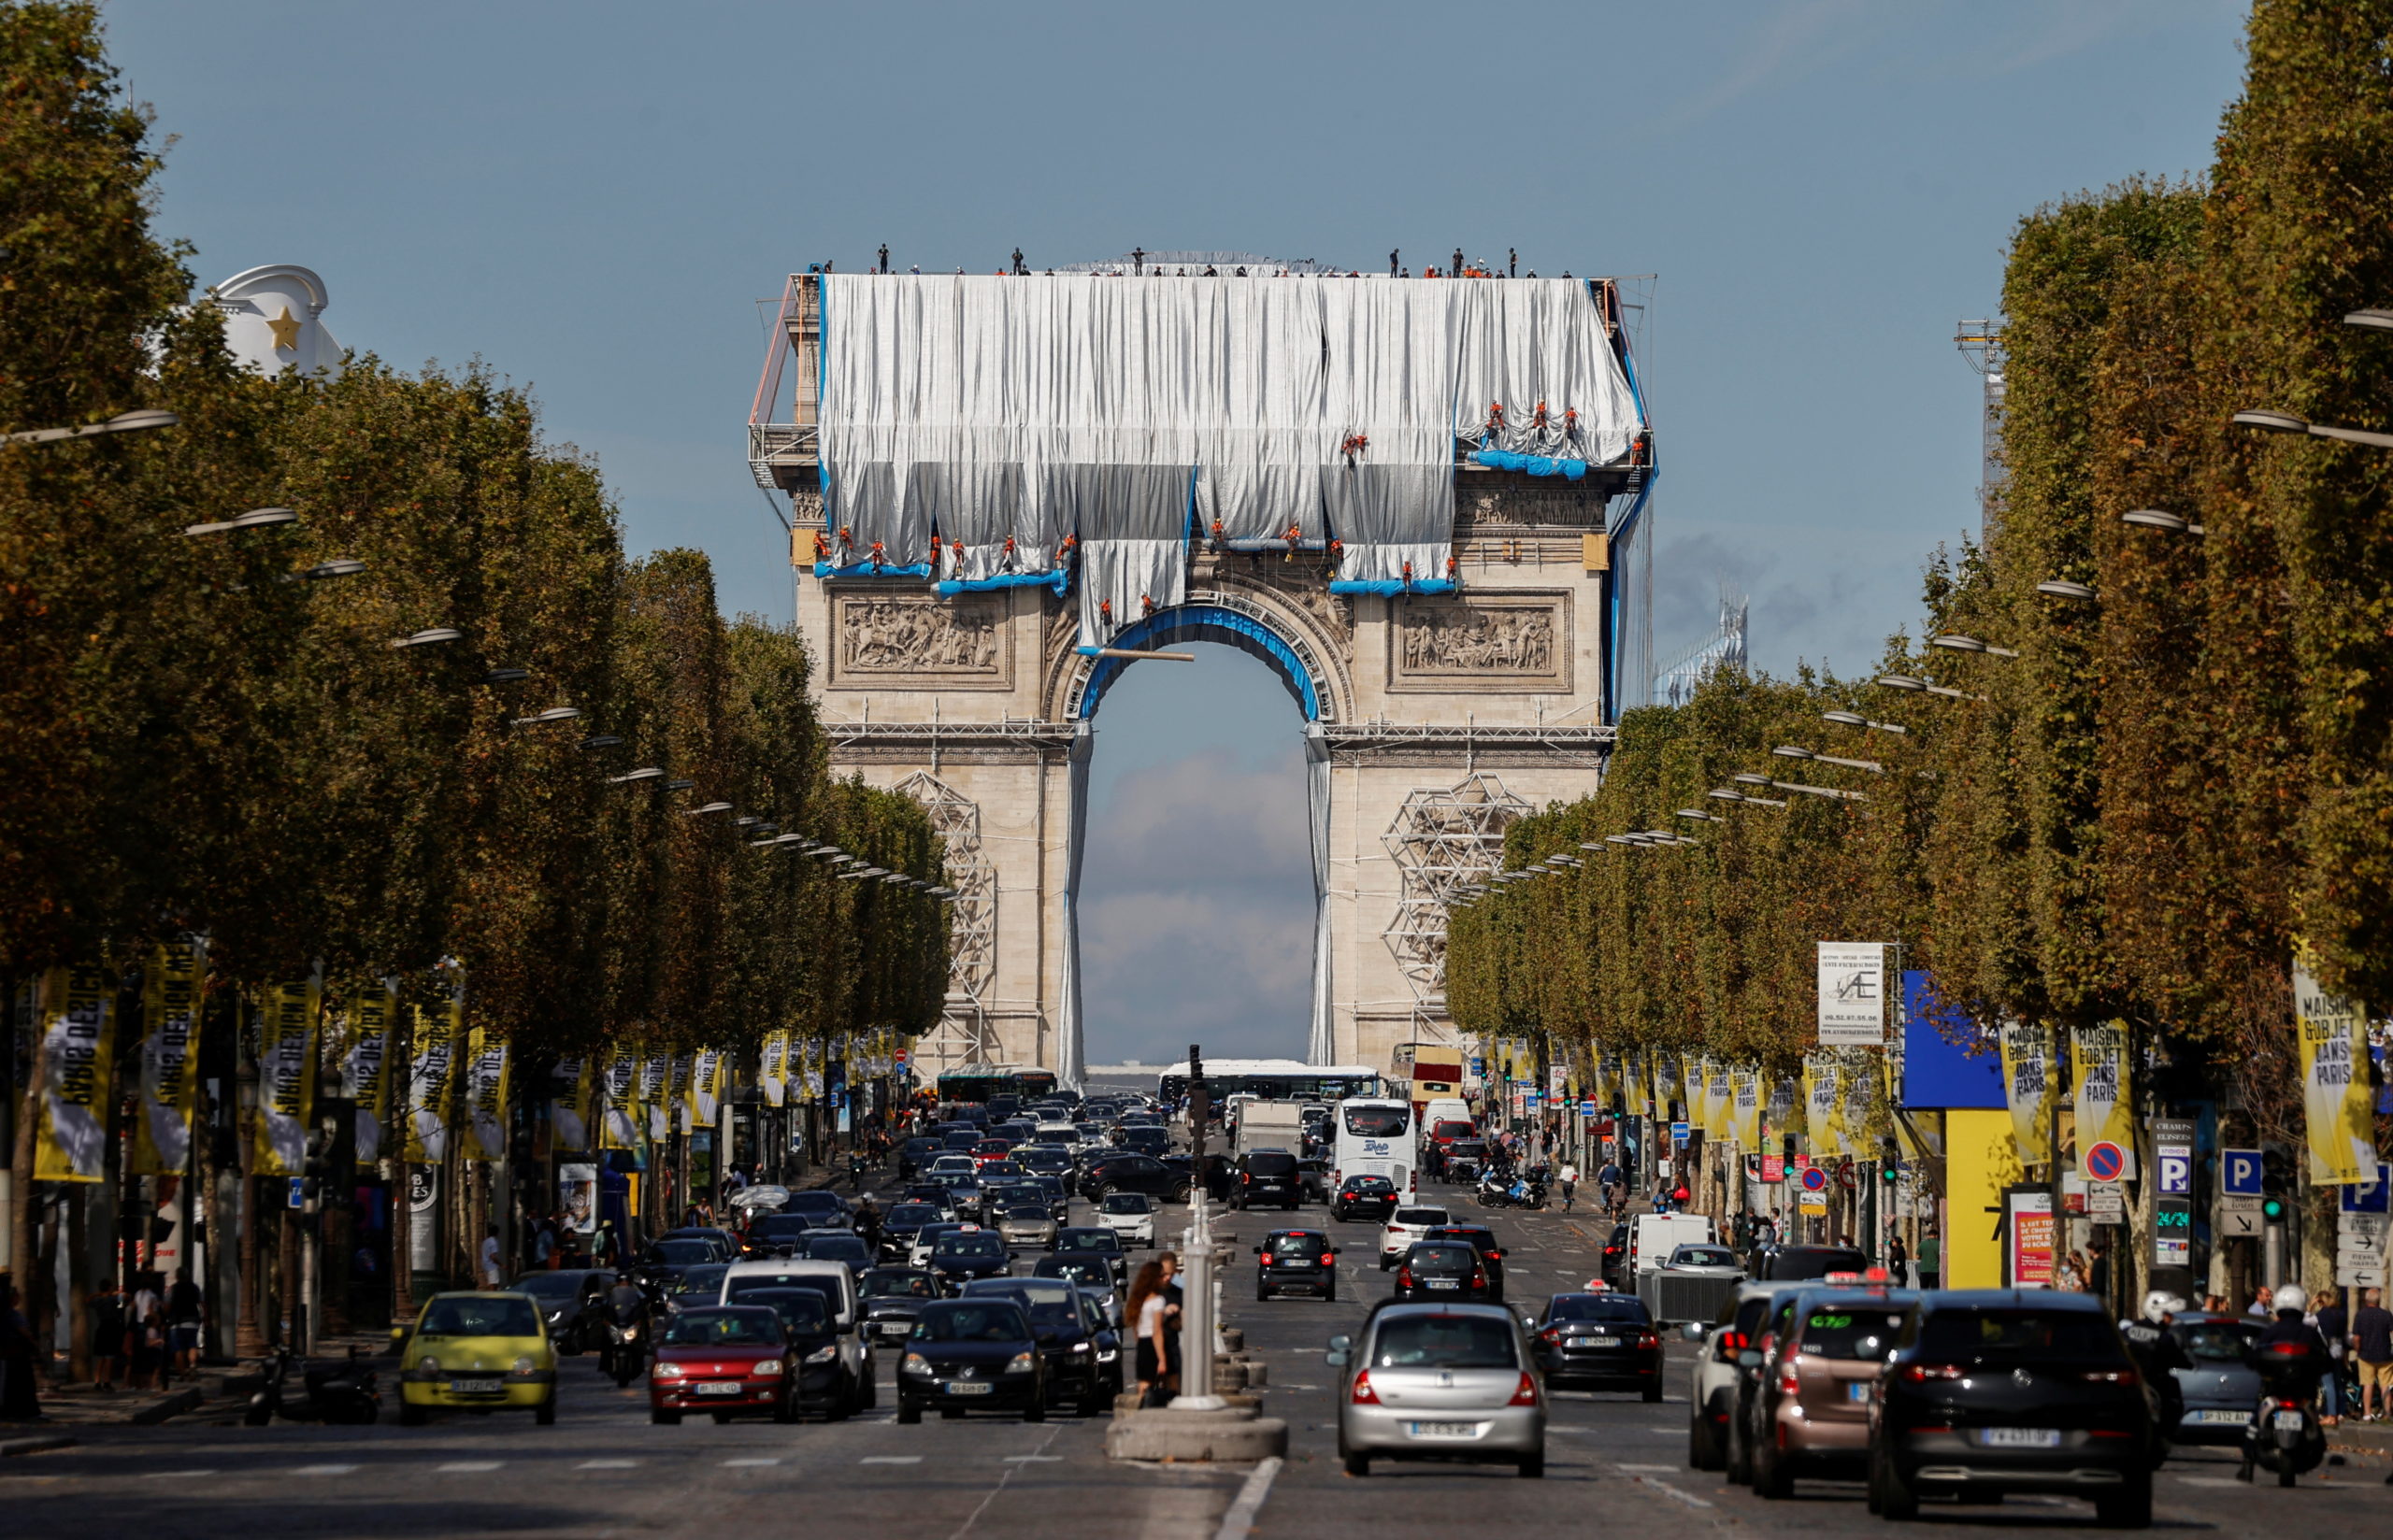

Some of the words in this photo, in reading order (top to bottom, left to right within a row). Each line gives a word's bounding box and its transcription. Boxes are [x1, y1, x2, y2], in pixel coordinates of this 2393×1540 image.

[2303, 995, 2354, 1017] MAISON
[2008, 1027, 2045, 1044] MAISON
[2079, 1029, 2119, 1045] MAISON
[2316, 1041, 2347, 1062] DANS
[2017, 1061, 2042, 1077] DANS
[2086, 1066, 2115, 1083] DANS
[2317, 1062, 2350, 1086] PARIS
[1711, 1076, 1727, 1086] DANS
[2017, 1077, 2045, 1094] PARIS
[1711, 1086, 1728, 1097] PARIS
[1738, 1085, 1755, 1096] DANS
[2086, 1085, 2117, 1103] PARIS
[1738, 1096, 1757, 1106] PARIS
[2234, 1159, 2252, 1187] P
